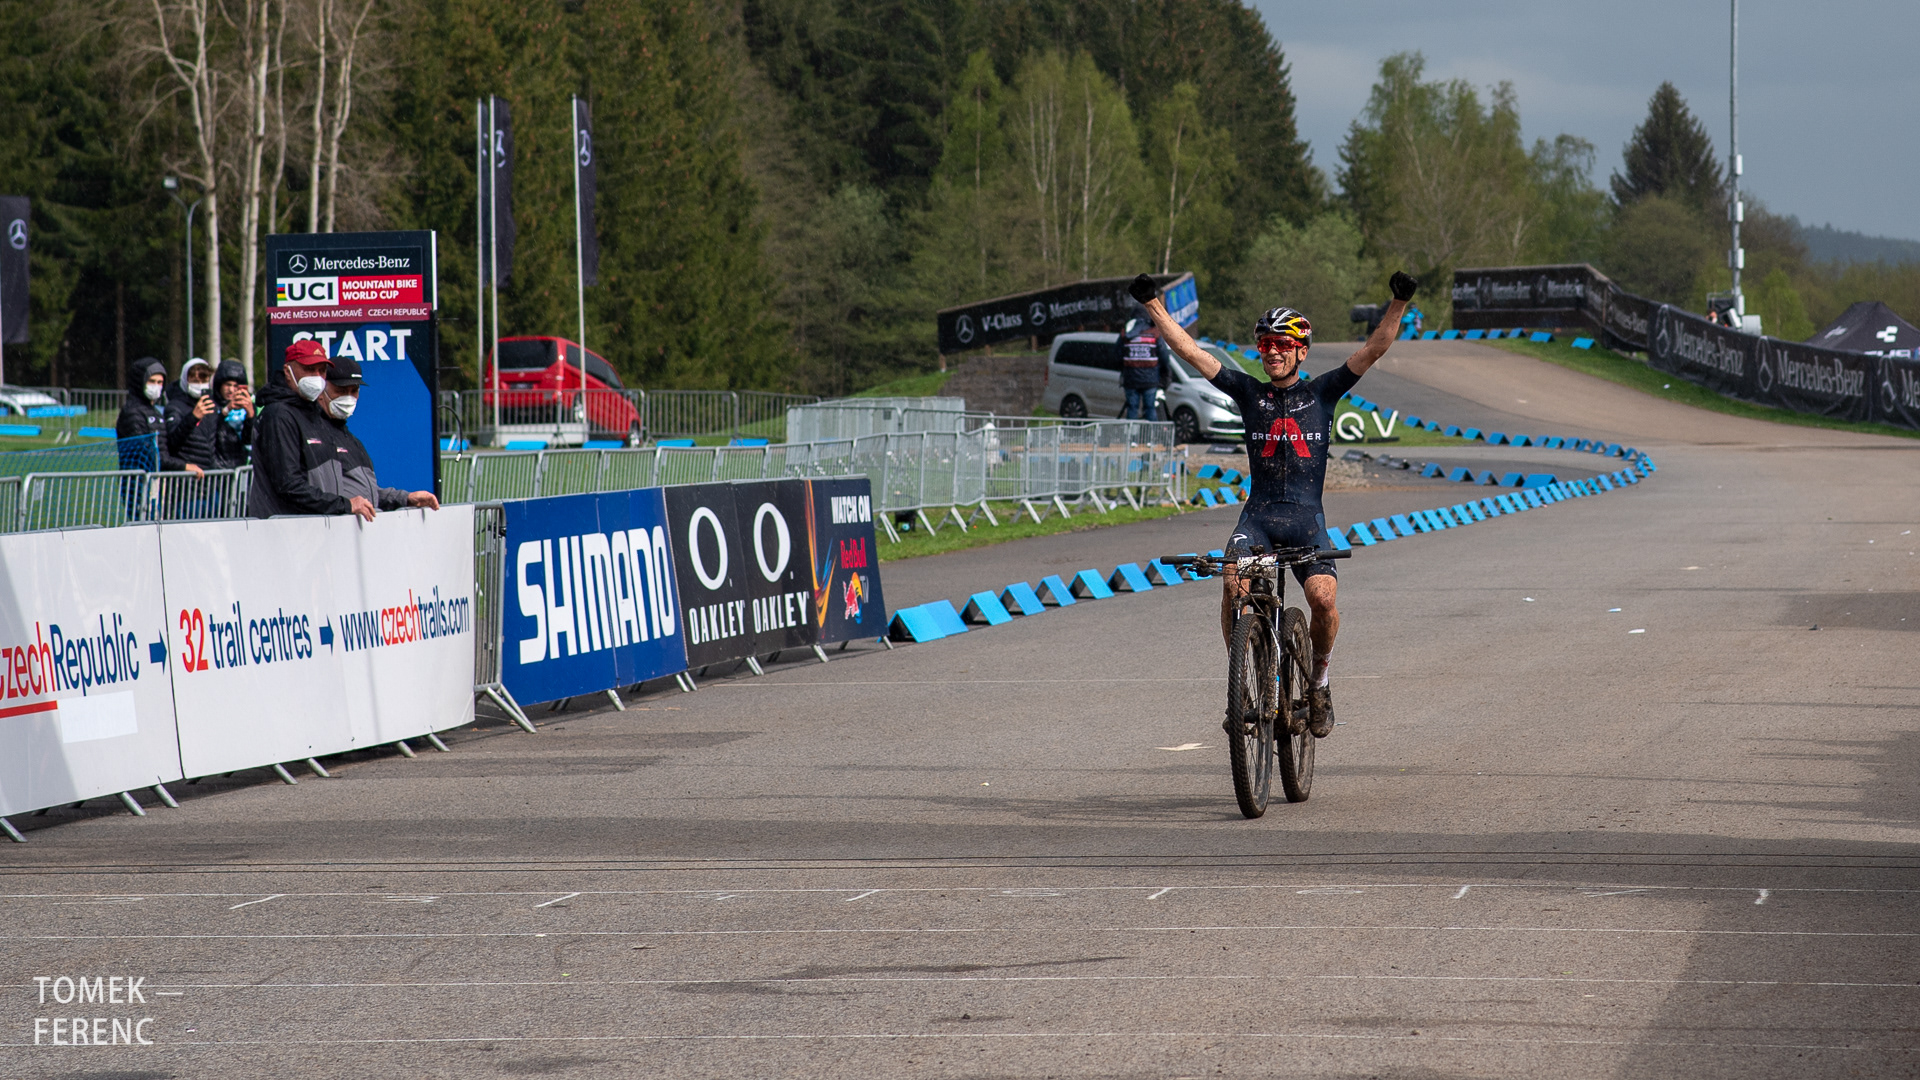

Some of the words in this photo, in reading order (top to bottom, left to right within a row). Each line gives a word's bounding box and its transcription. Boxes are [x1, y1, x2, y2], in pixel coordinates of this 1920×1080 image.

[313, 255, 410, 270] Mercedes-Benz
[287, 282, 333, 301] UCI
[342, 279, 395, 290] MOUNTAIN
[396, 279, 418, 289] BIKE
[342, 291, 378, 300] WORLD
[379, 290, 399, 300] CUP
[270, 311, 291, 320] NOVÉ
[319, 310, 331, 318] NA
[367, 308, 392, 317] CZECH
[393, 308, 428, 317] REPUBLIC
[981, 312, 1022, 332] V-Class
[1777, 349, 1864, 397] Mercedes-Benz
[1252, 432, 1322, 441] GRENADIER
[1336, 410, 1399, 441] QV
[831, 496, 858, 524] WATCH
[858, 495, 871, 523] ON
[516, 525, 676, 665] SHIMANO
[340, 585, 470, 652] www.czechtrails.com
[688, 600, 744, 645] OAKLEY
[752, 591, 809, 634] OAKLEY
[180, 608, 209, 673] 32
[209, 601, 247, 669] trail
[249, 607, 313, 665] centres
